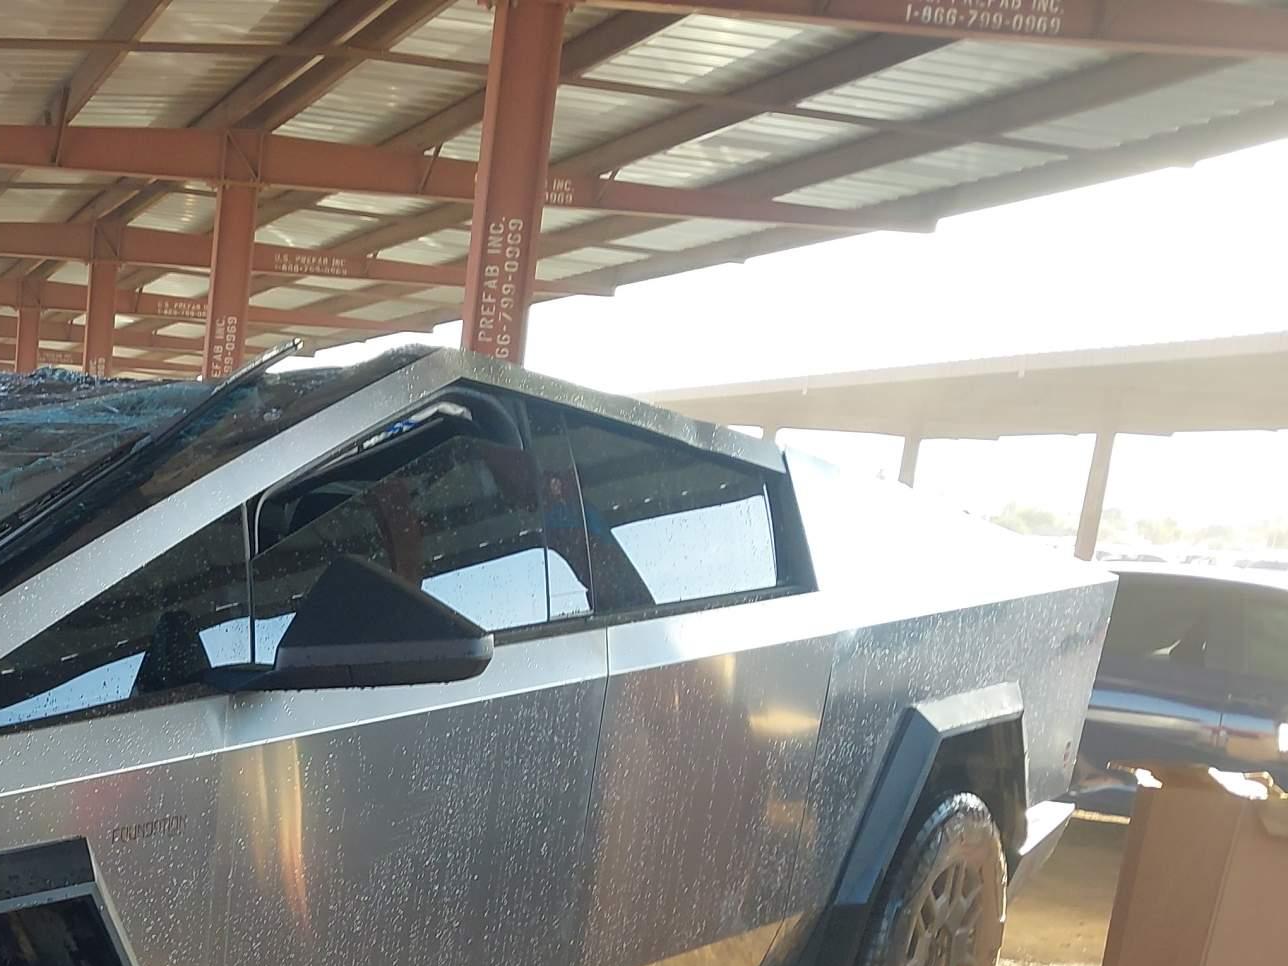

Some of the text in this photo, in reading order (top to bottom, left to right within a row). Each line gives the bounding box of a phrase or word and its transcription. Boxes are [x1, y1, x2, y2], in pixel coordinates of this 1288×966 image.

[478, 216, 507, 342] PREFAB INC.
[495, 218, 523, 359] 66-799-0969
[211, 345, 224, 377] EFAB
